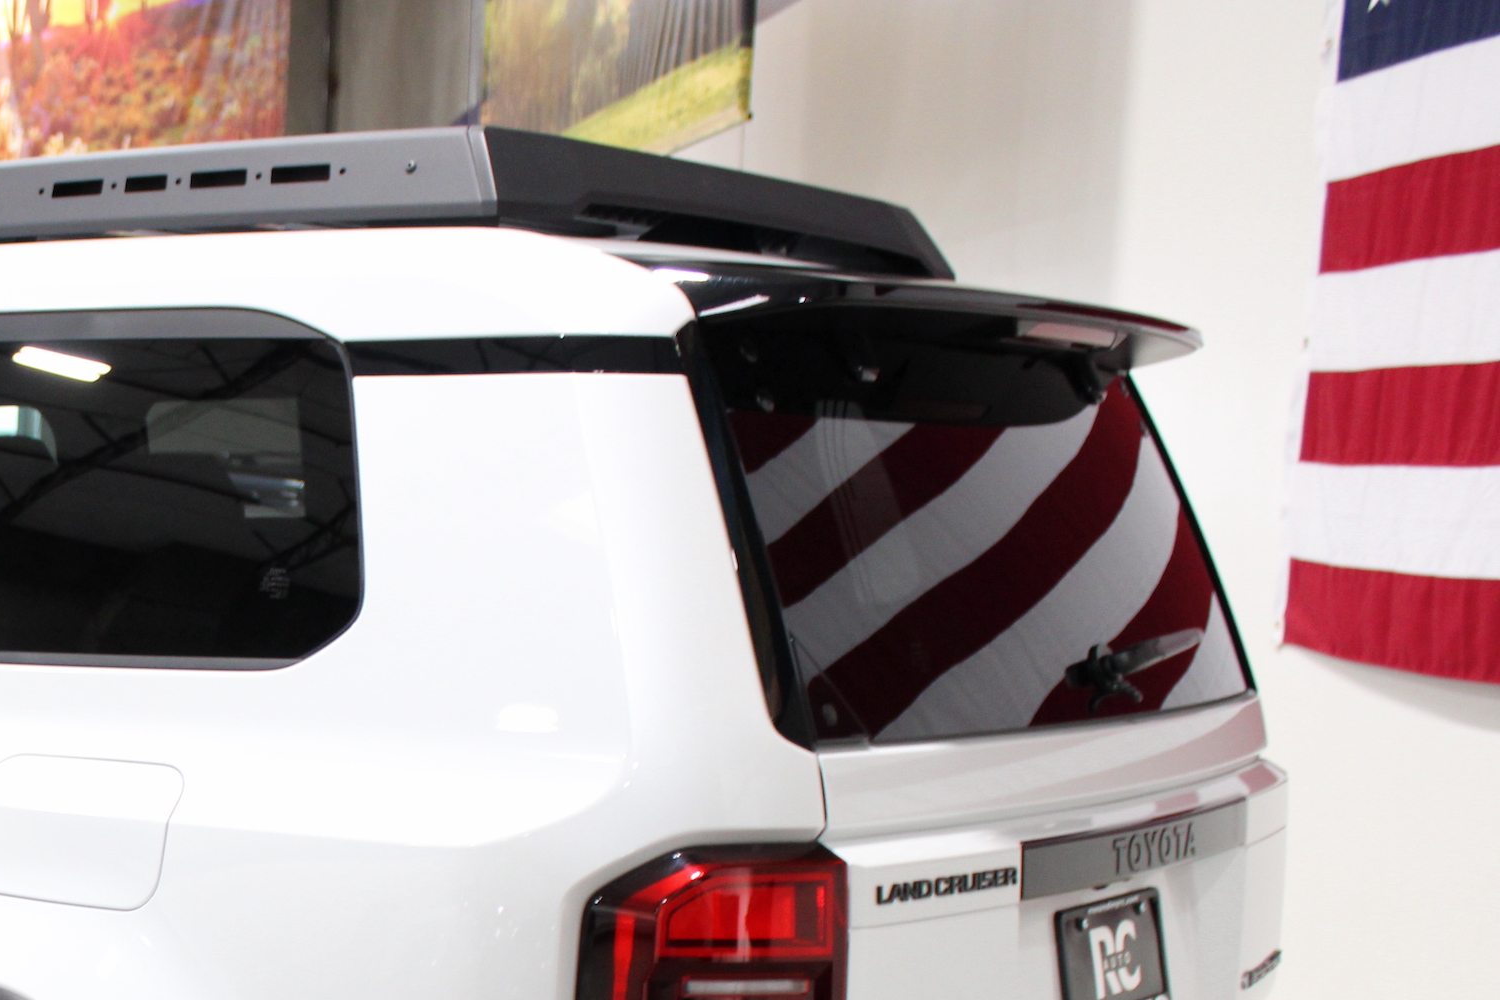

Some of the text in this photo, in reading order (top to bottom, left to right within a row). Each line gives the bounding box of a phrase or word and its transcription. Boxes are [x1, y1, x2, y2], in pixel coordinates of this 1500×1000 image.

[1112, 822, 1196, 876] TOYOTA
[875, 867, 1017, 906] LAND CRUISER
[1089, 919, 1142, 1000] RC
[1104, 950, 1132, 971] AUTO
